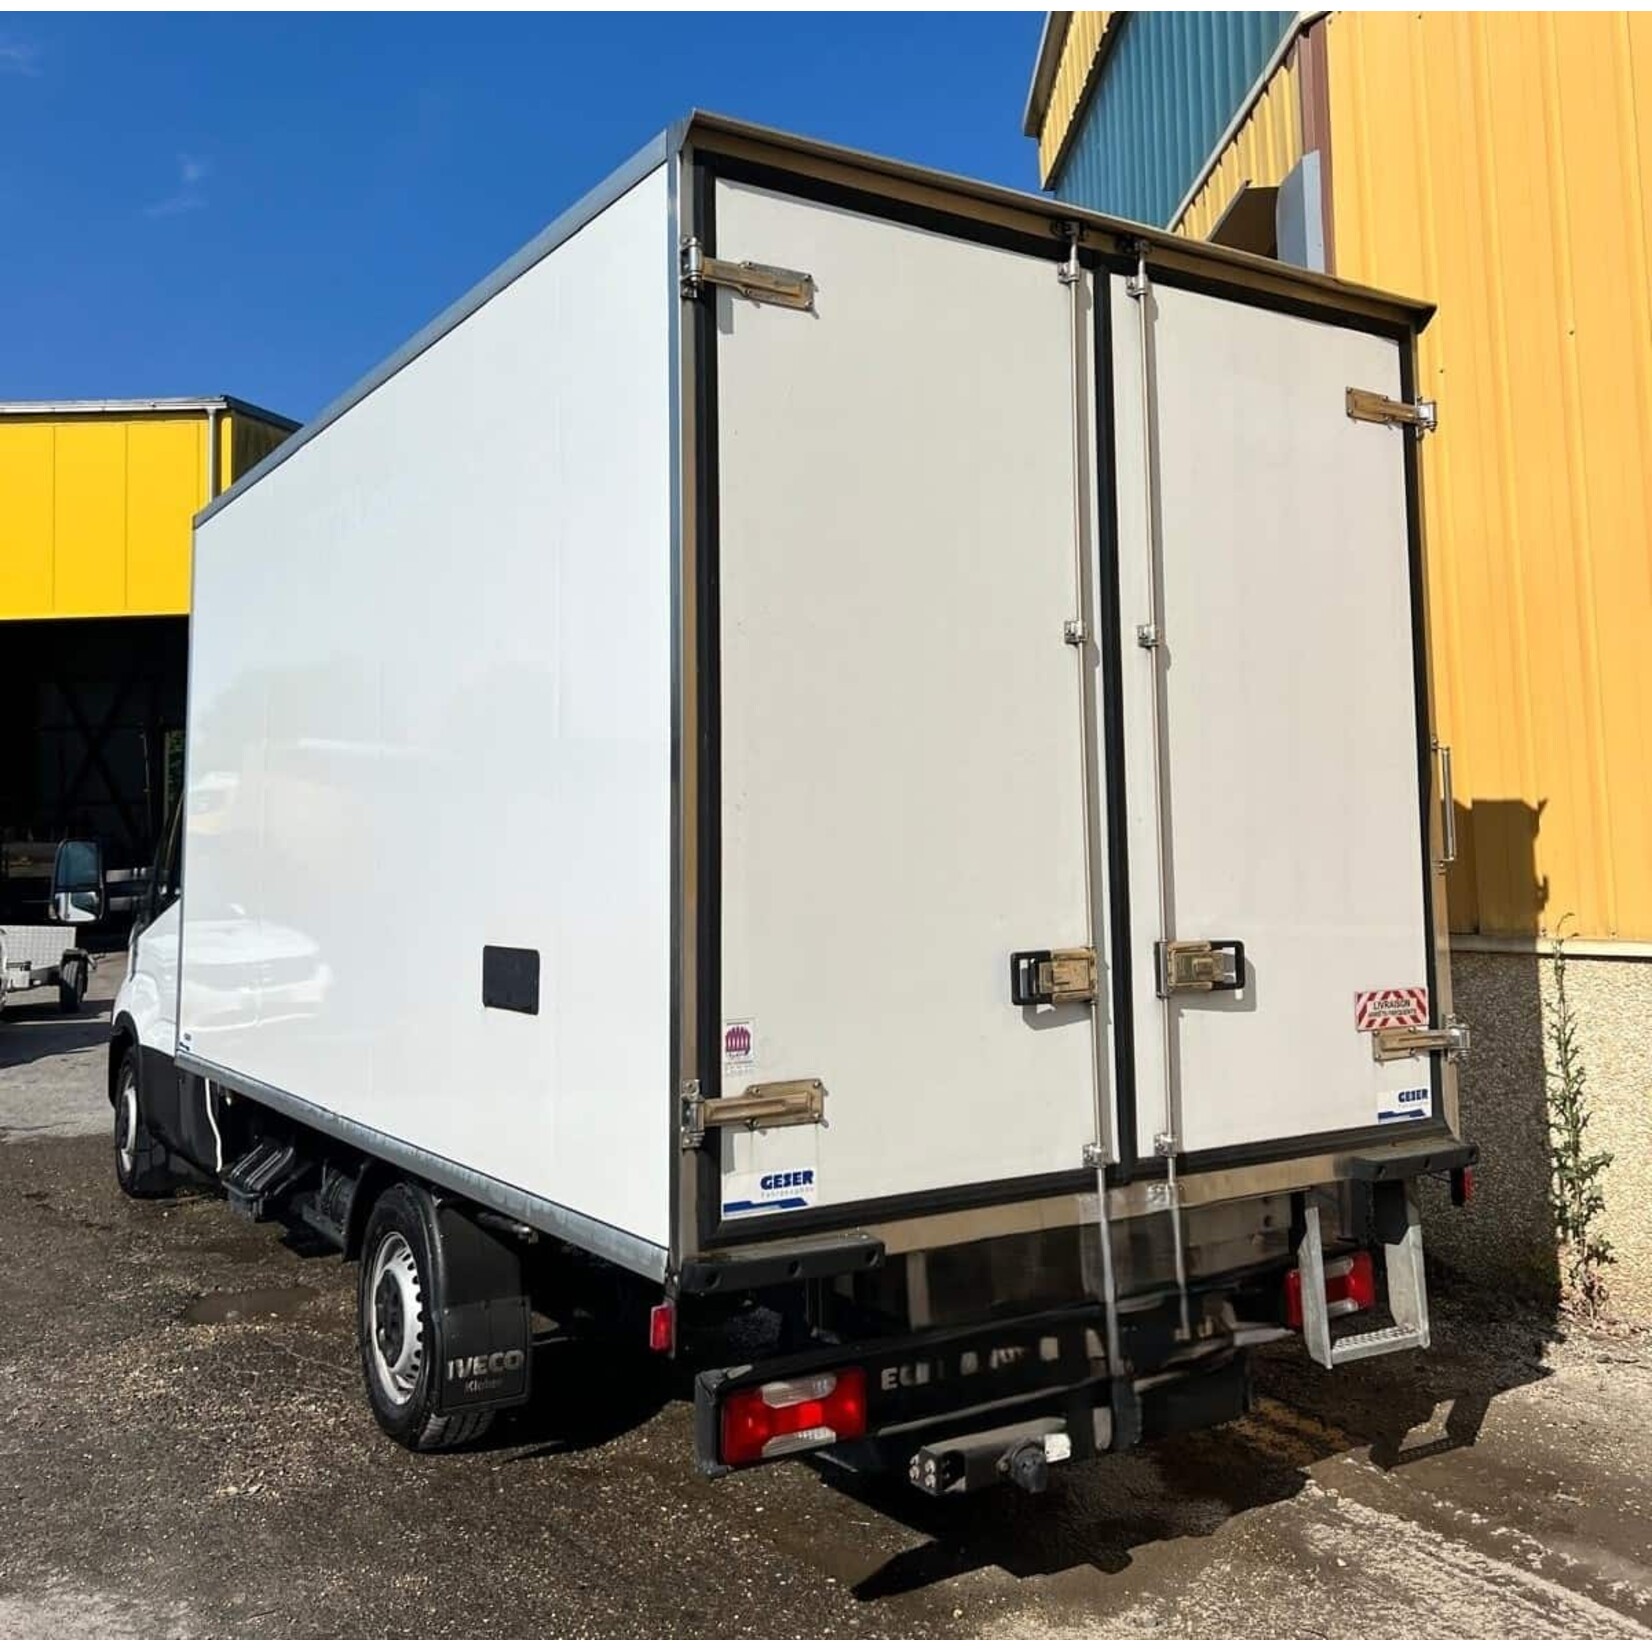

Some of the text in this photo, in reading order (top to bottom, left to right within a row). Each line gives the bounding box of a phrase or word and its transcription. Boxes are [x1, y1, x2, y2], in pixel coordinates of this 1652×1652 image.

[1373, 999, 1411, 1010] LIVRAISON
[760, 1170, 814, 1190] GESER
[447, 1349, 524, 1380] IVECO
